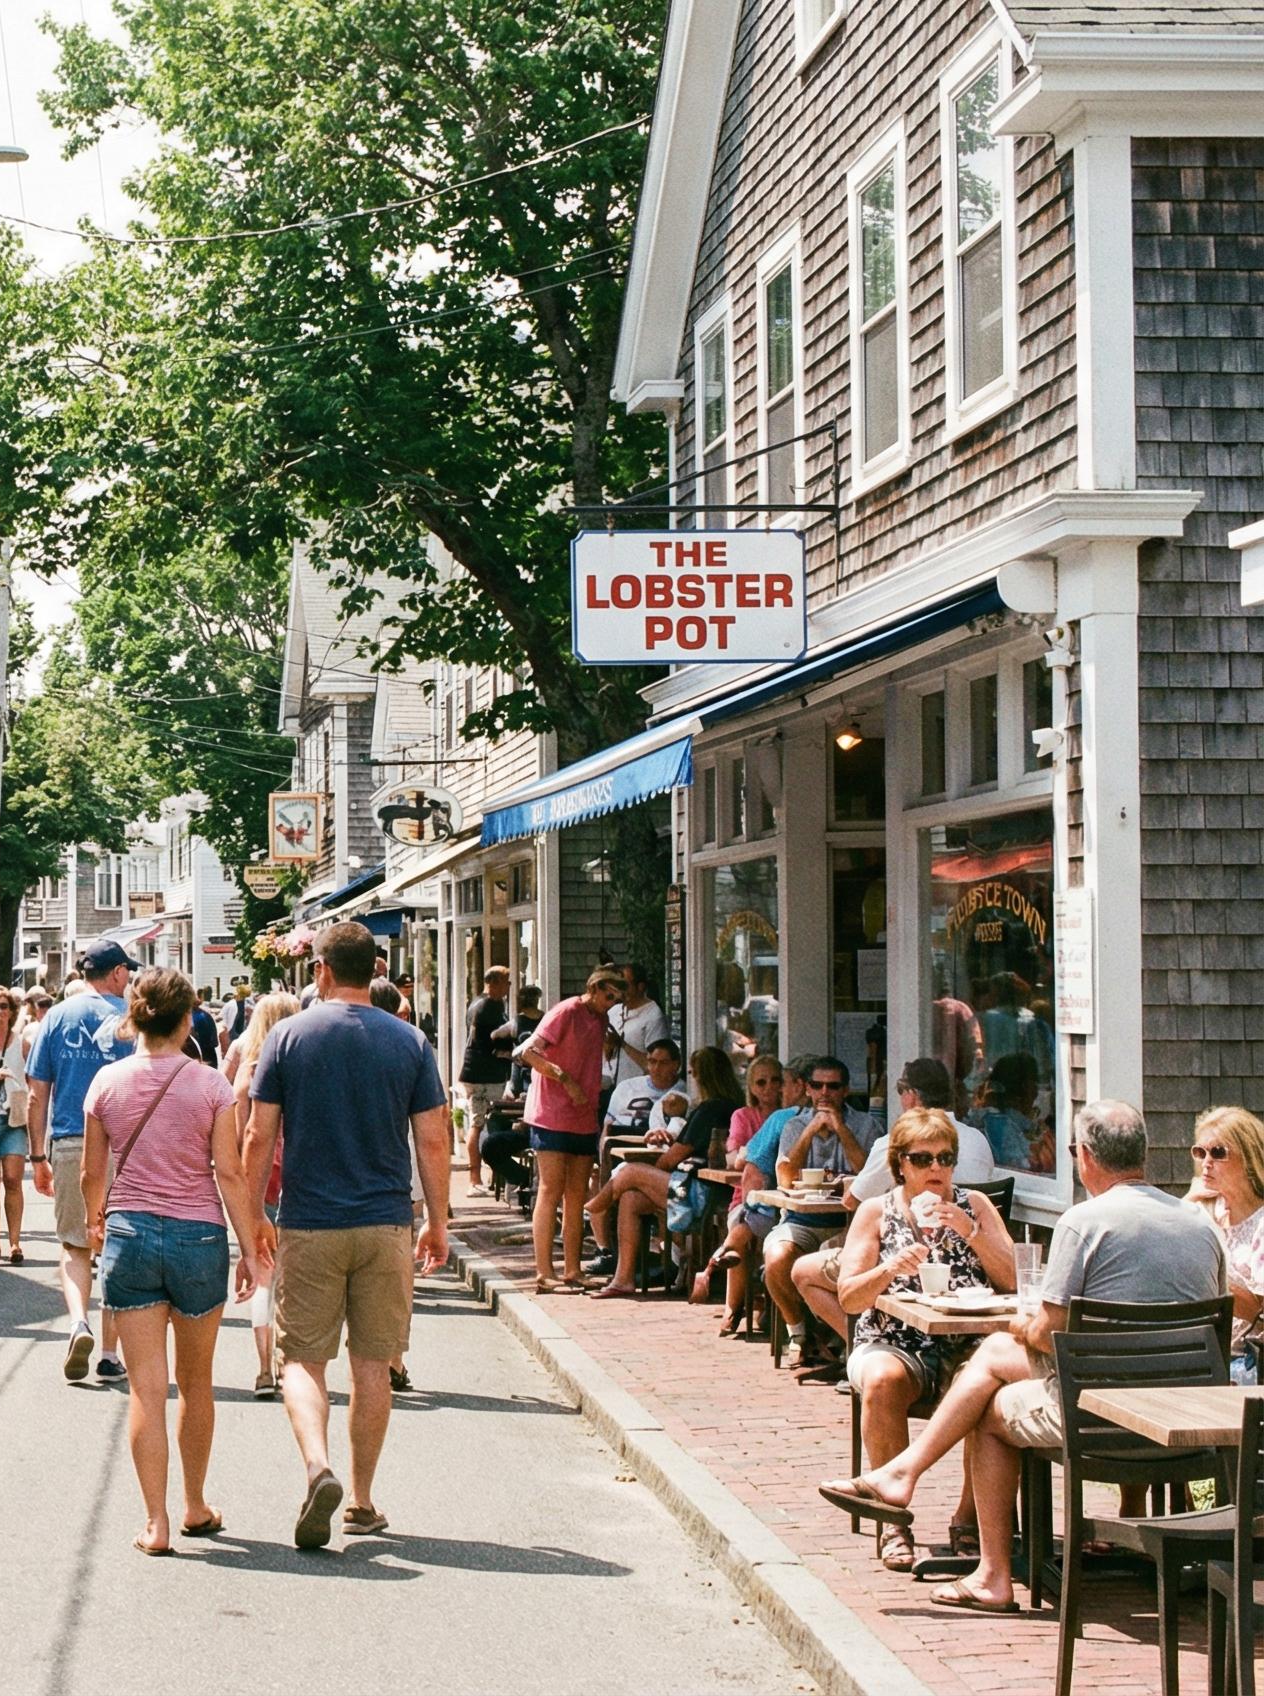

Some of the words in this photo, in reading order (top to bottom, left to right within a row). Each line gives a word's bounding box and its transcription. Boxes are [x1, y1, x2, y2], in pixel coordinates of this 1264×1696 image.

[649, 541, 727, 567] THE
[586, 573, 793, 609] LOBSTER
[645, 616, 736, 650] POT
